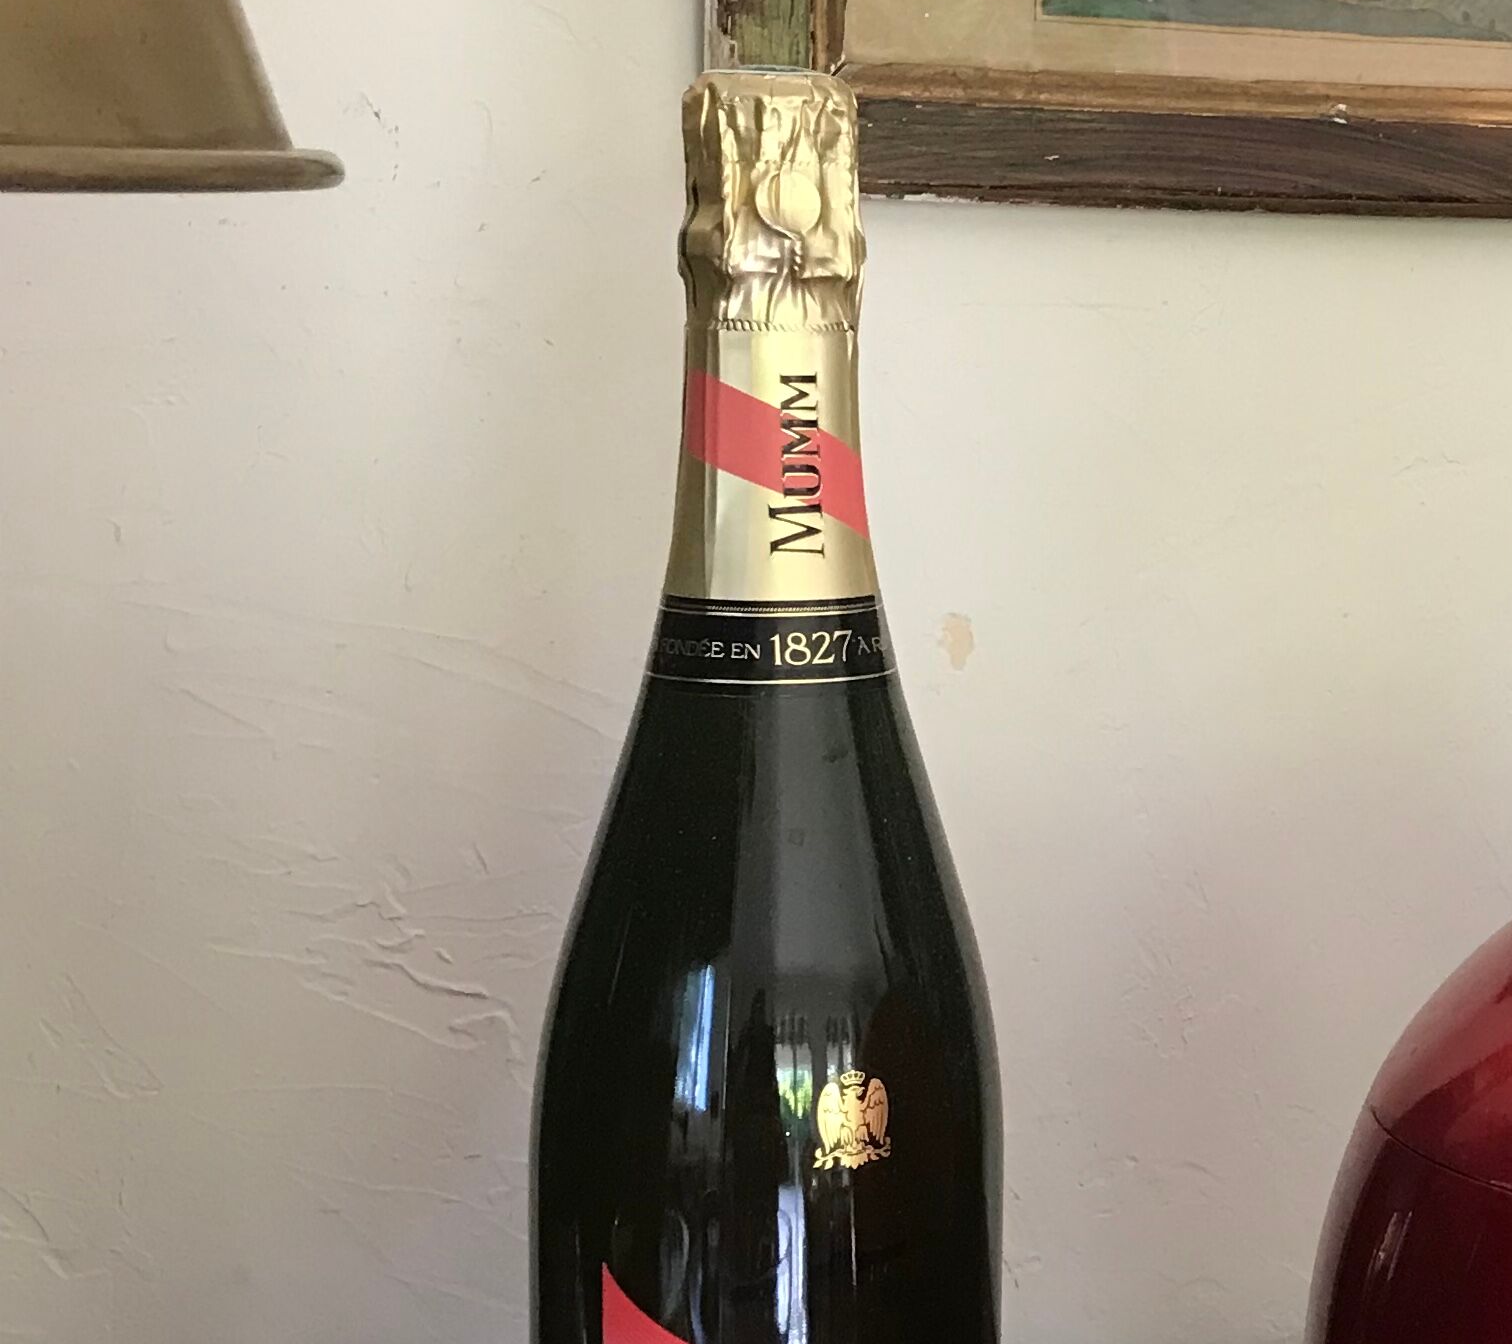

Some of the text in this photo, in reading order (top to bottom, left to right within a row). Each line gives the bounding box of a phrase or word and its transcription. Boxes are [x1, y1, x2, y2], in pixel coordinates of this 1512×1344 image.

[766, 372, 826, 559] MUMM
[731, 641, 761, 660] EN
[769, 629, 853, 667] 1827
